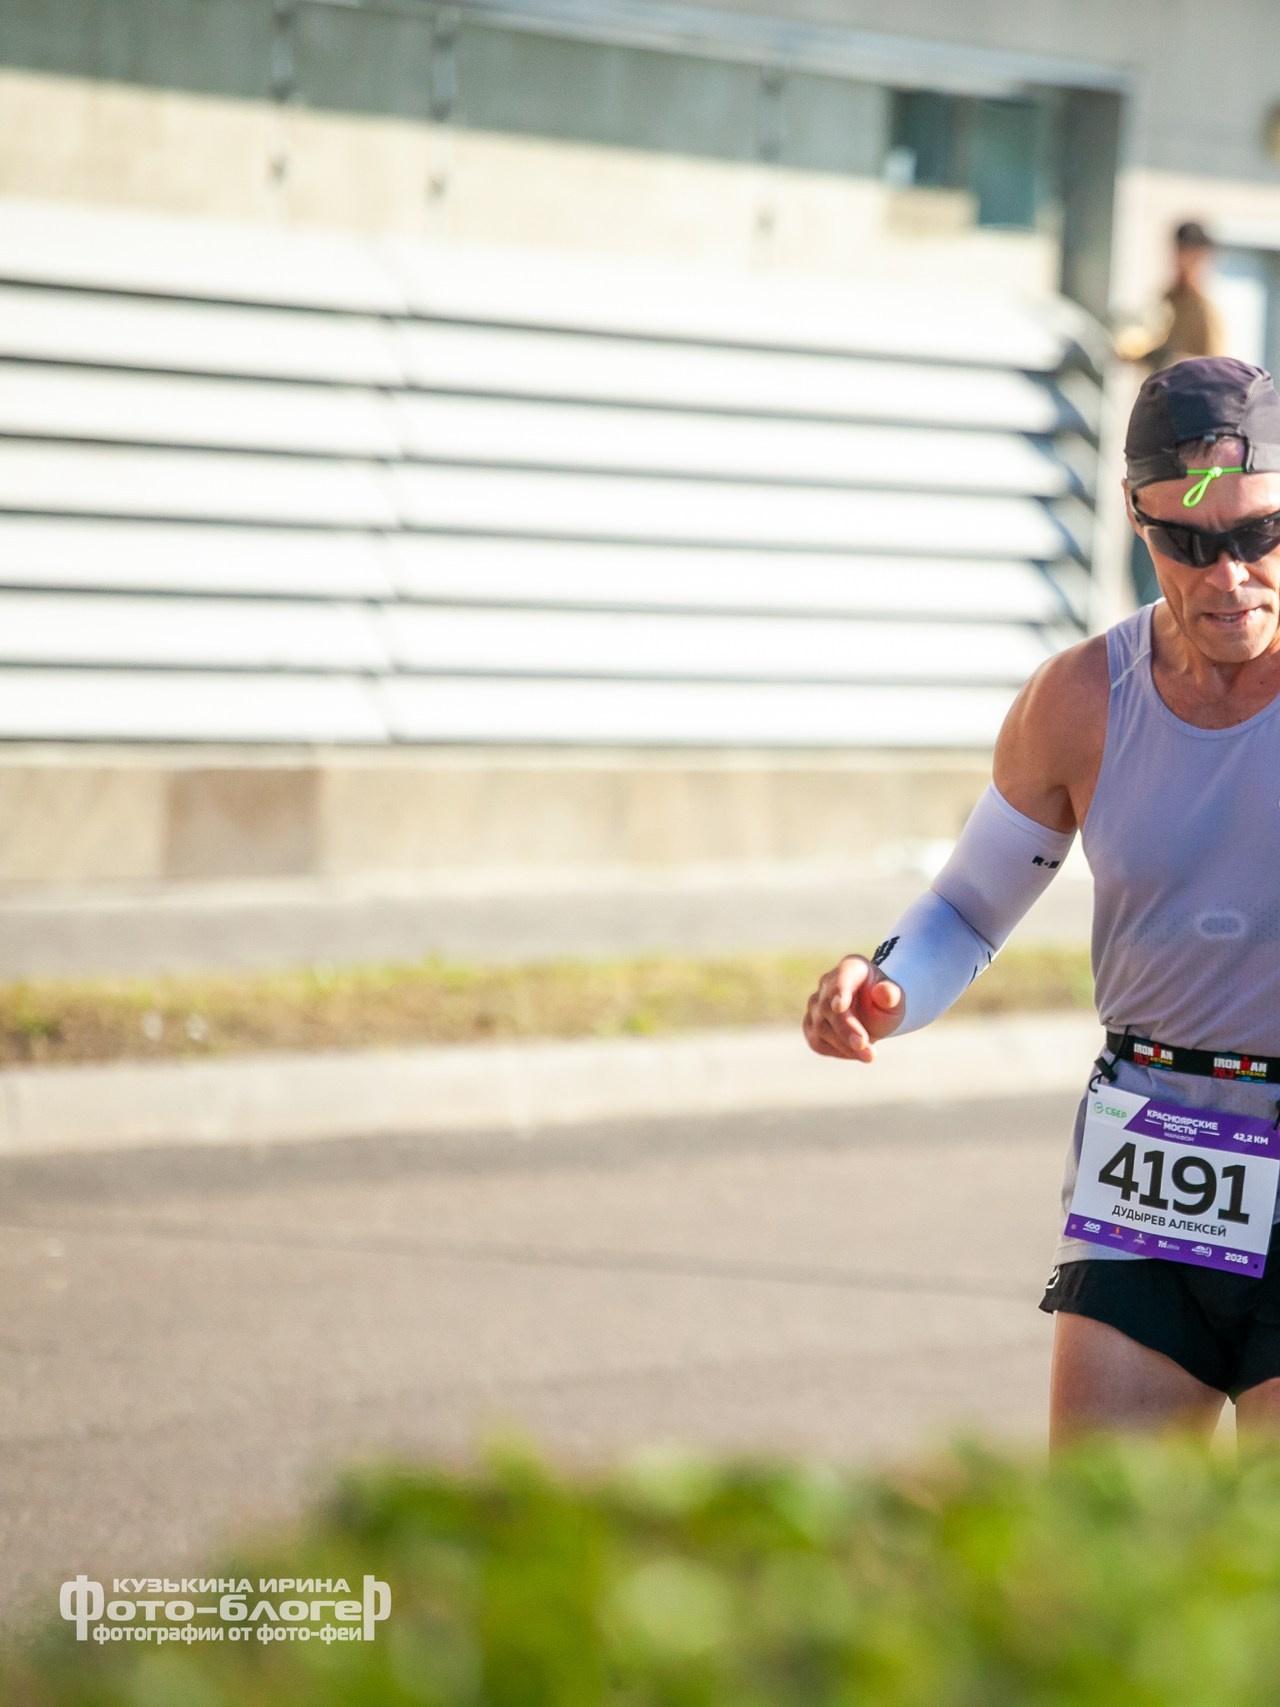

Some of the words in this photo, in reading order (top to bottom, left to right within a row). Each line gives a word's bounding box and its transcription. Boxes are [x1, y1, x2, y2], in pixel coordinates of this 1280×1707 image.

[1105, 1106, 1127, 1119] СБЕР
[1146, 1109, 1219, 1131] КРАСНОЯРСКИЕ
[1163, 1121, 1198, 1135] МОСТЫ
[1232, 1132, 1253, 1144] 42,2
[1254, 1134, 1269, 1146] КМ
[1098, 1141, 1250, 1225] 4191
[1111, 1204, 1166, 1228] ДУДЫРЕВ
[1168, 1218, 1228, 1238] АЛЕКСЕЙ
